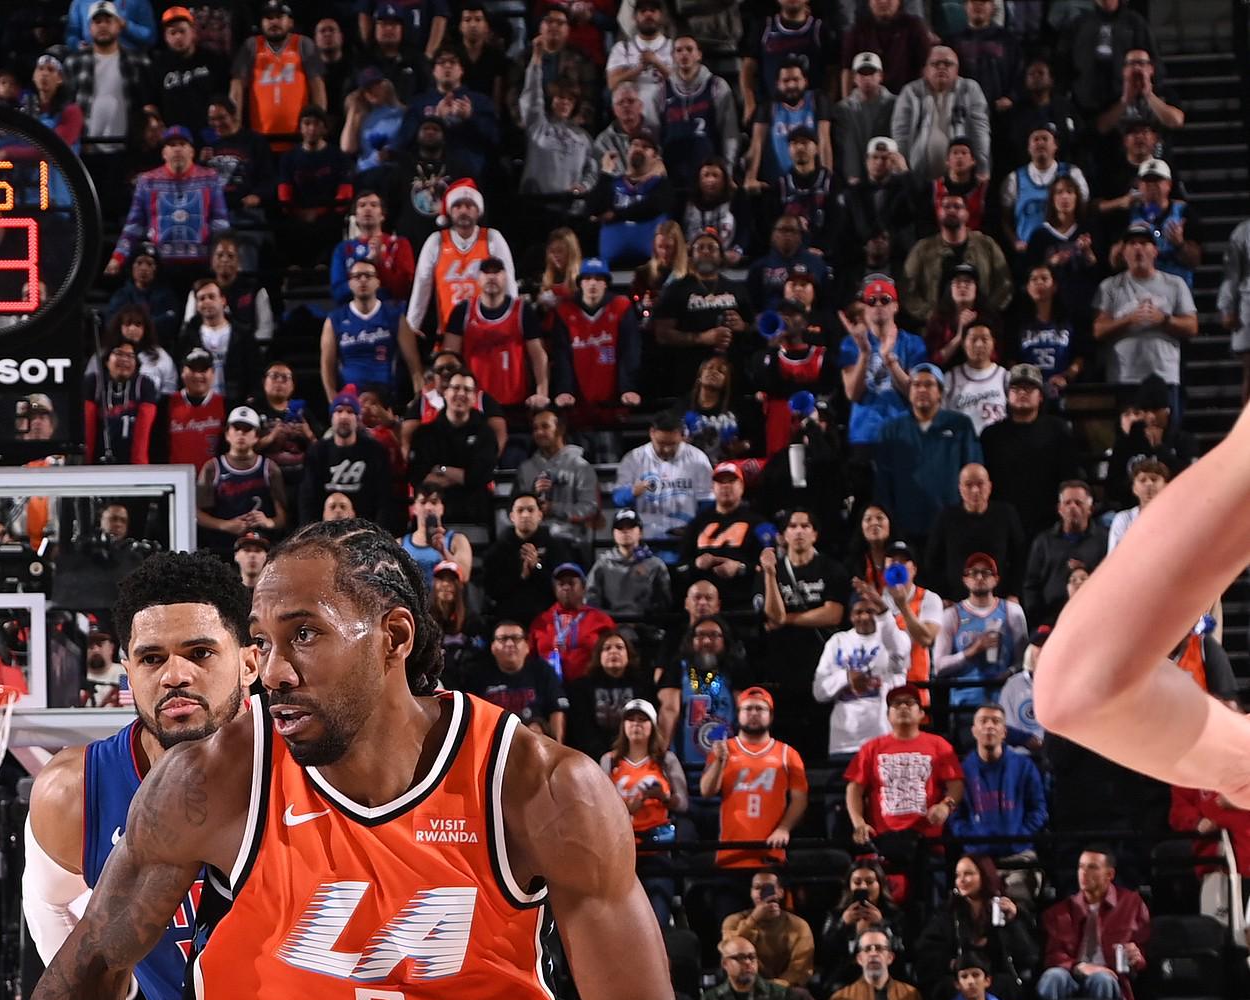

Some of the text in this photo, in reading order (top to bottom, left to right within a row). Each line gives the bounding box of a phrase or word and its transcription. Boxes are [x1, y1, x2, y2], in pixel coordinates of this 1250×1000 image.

[259, 62, 297, 85] LA
[693, 117, 707, 137] 2
[697, 521, 750, 549] LA
[733, 766, 778, 791] LA
[429, 818, 467, 831] VISIT
[415, 830, 479, 844] RWANDA
[275, 880, 479, 981] LA
